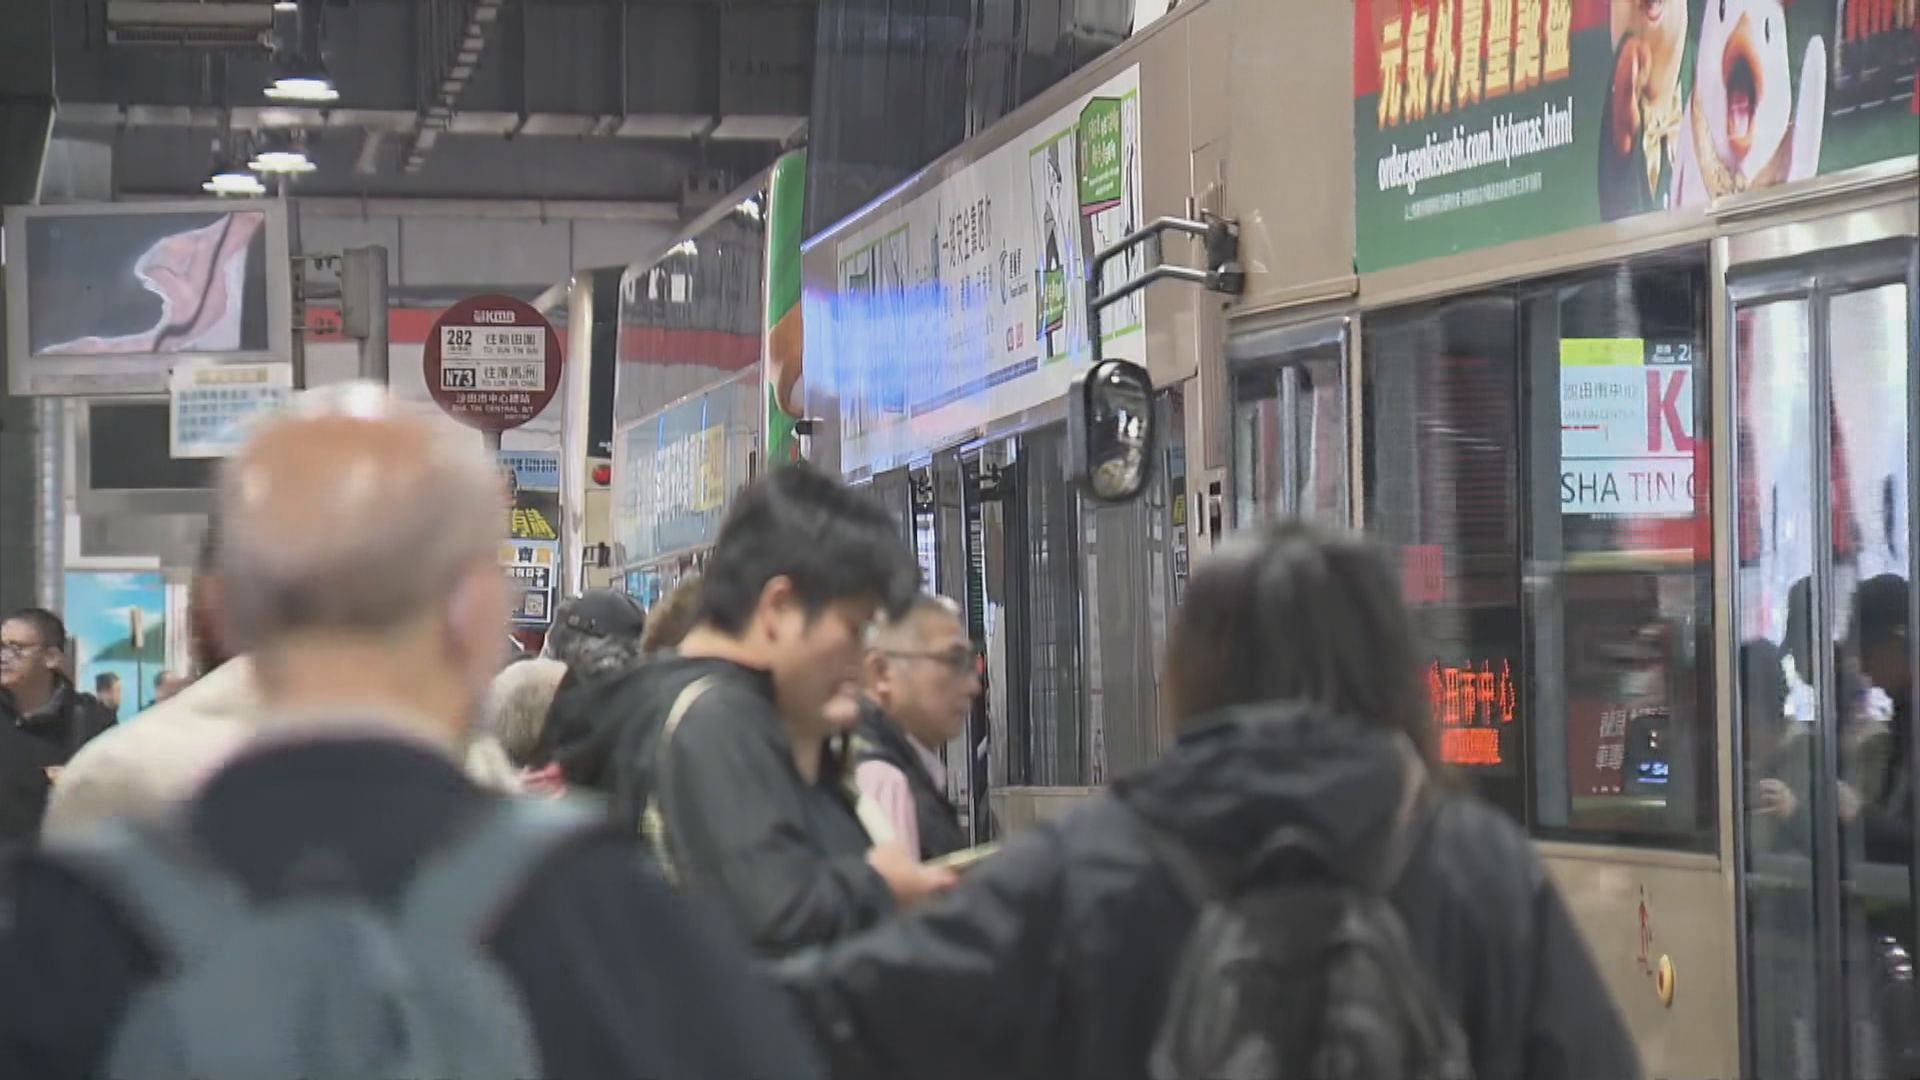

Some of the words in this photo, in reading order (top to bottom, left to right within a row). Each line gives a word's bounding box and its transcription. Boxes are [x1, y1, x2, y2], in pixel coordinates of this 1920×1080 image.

[1378, 96, 1573, 195] order.genkisushi.com.hk/xmas.html
[447, 329, 472, 345] 282
[445, 368, 473, 387] N73
[1561, 472, 1619, 503] SHA
[1629, 472, 1675, 501] TIN
